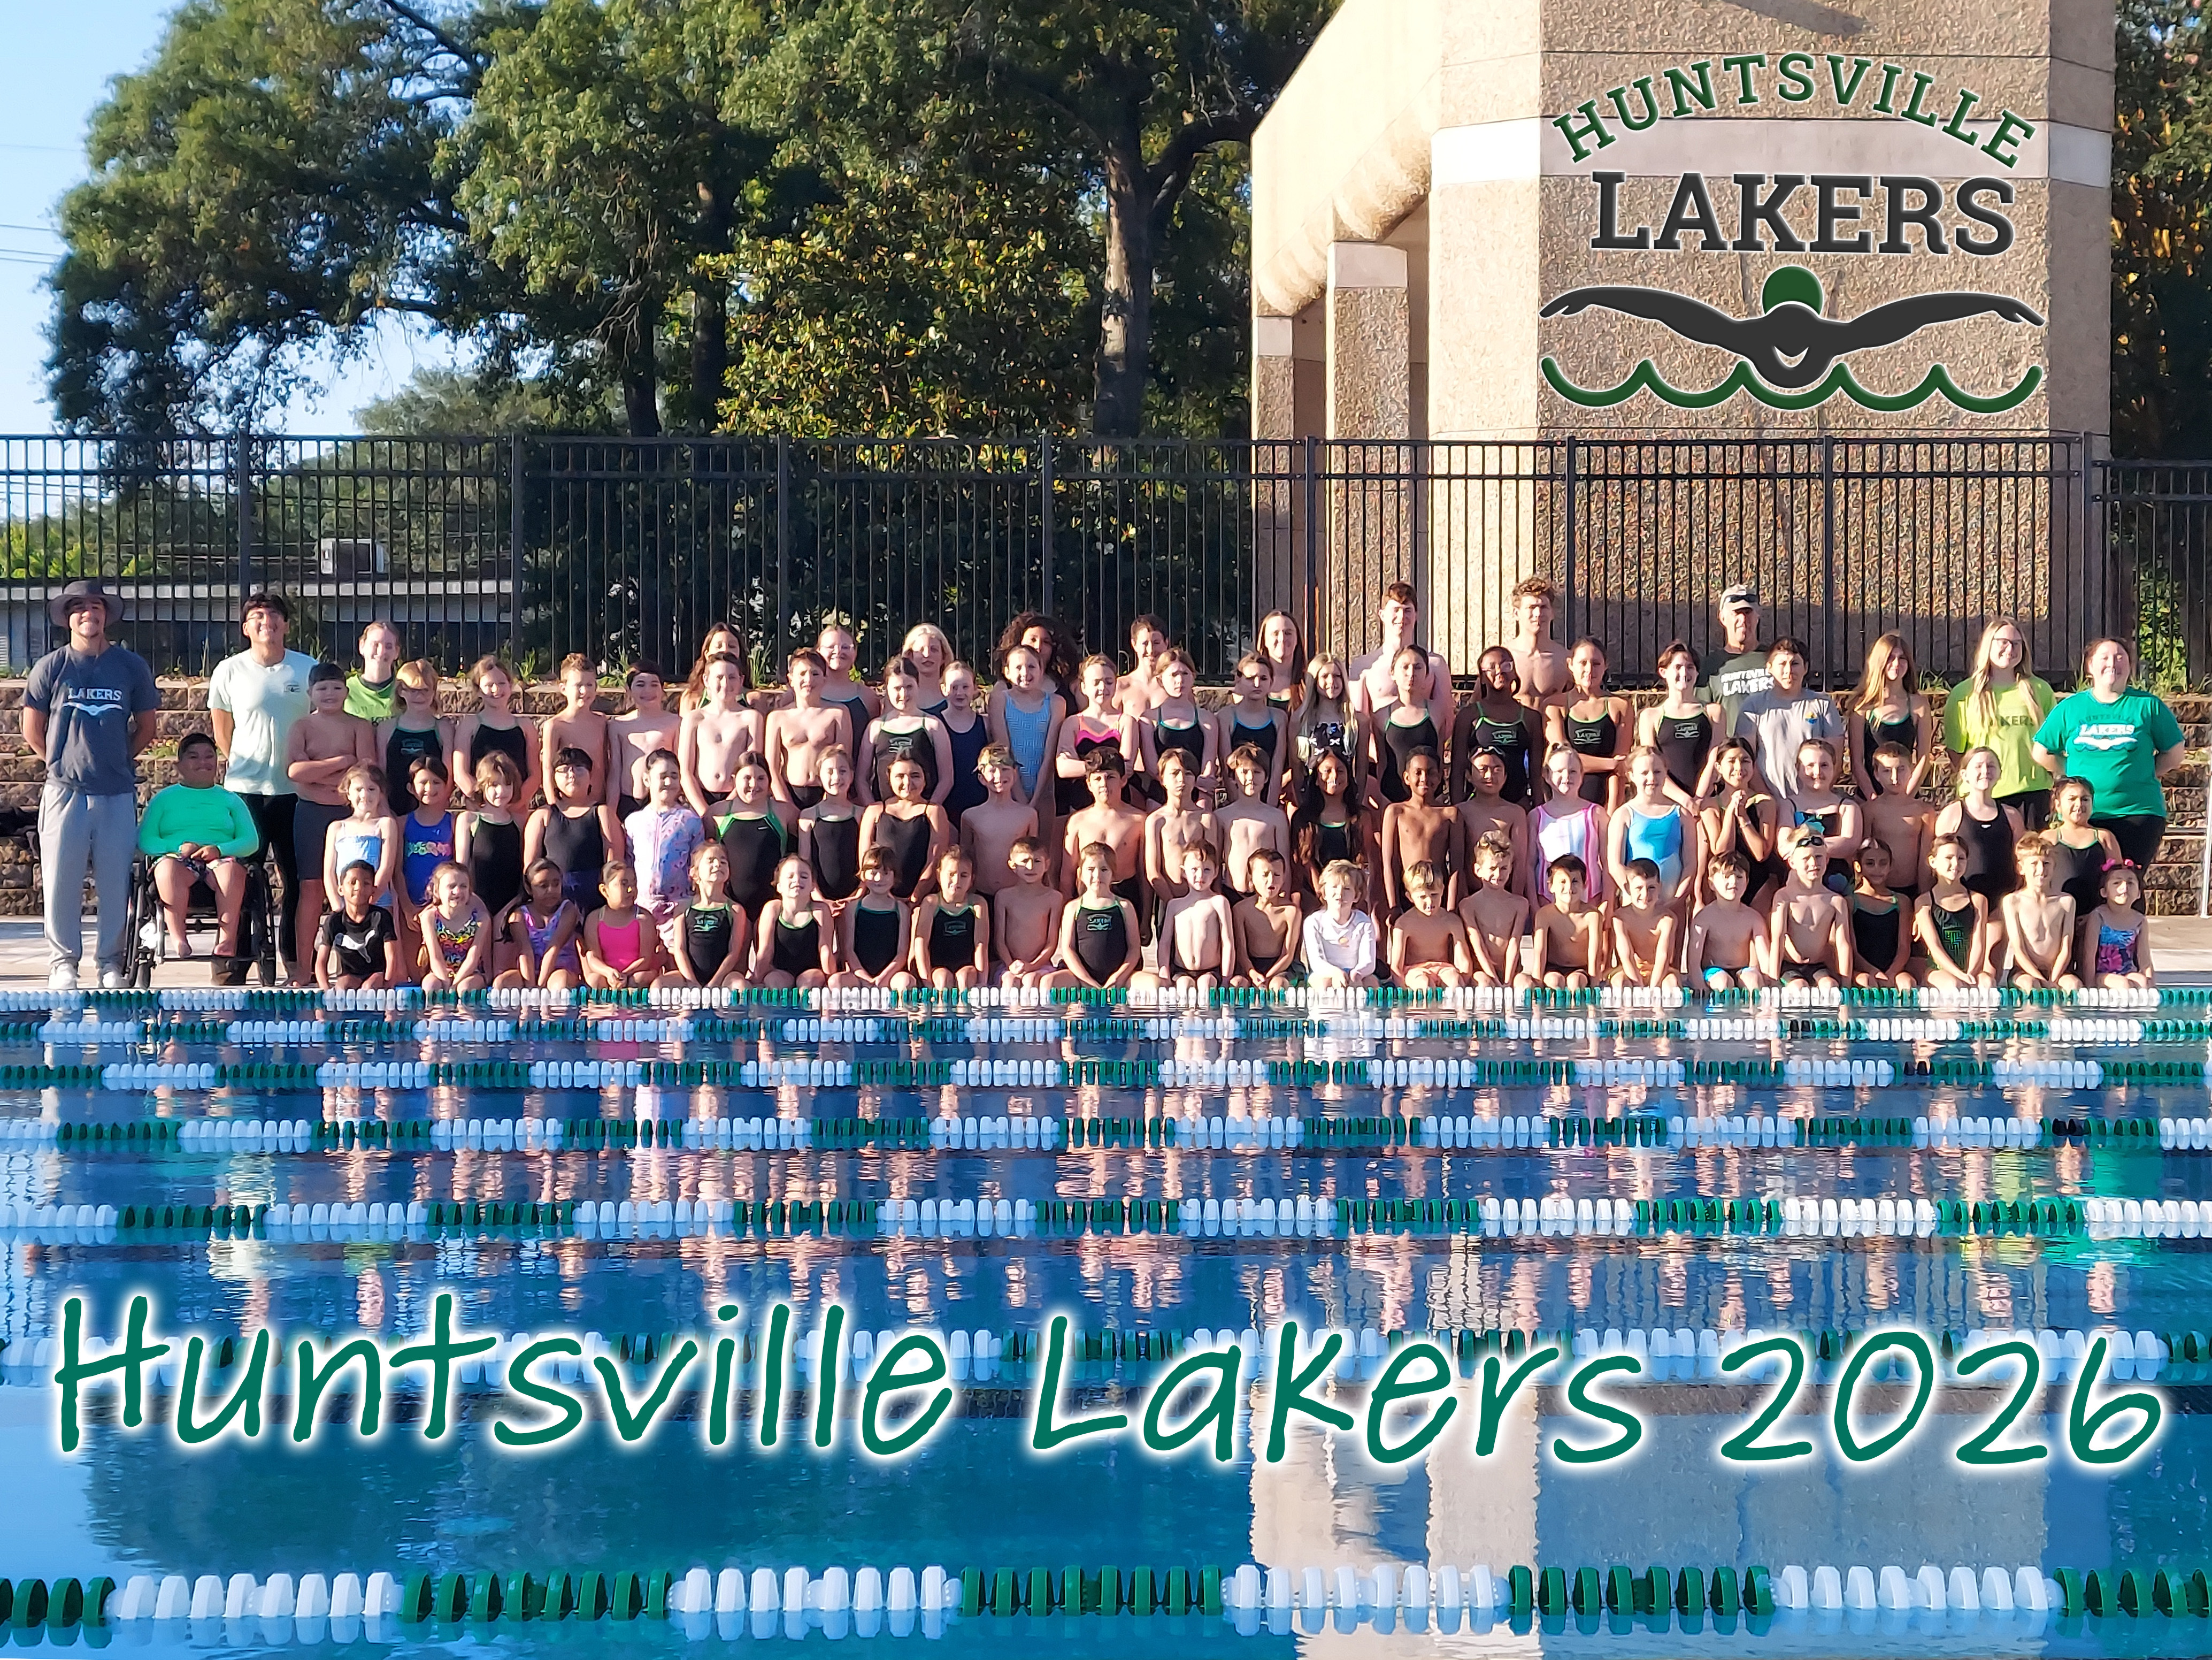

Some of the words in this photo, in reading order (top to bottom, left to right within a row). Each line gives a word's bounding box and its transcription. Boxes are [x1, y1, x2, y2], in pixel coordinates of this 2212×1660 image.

[1723, 676, 1774, 696] LAKERS
[68, 687, 122, 701] LAKERS
[2079, 723, 2136, 735] LAKERS
